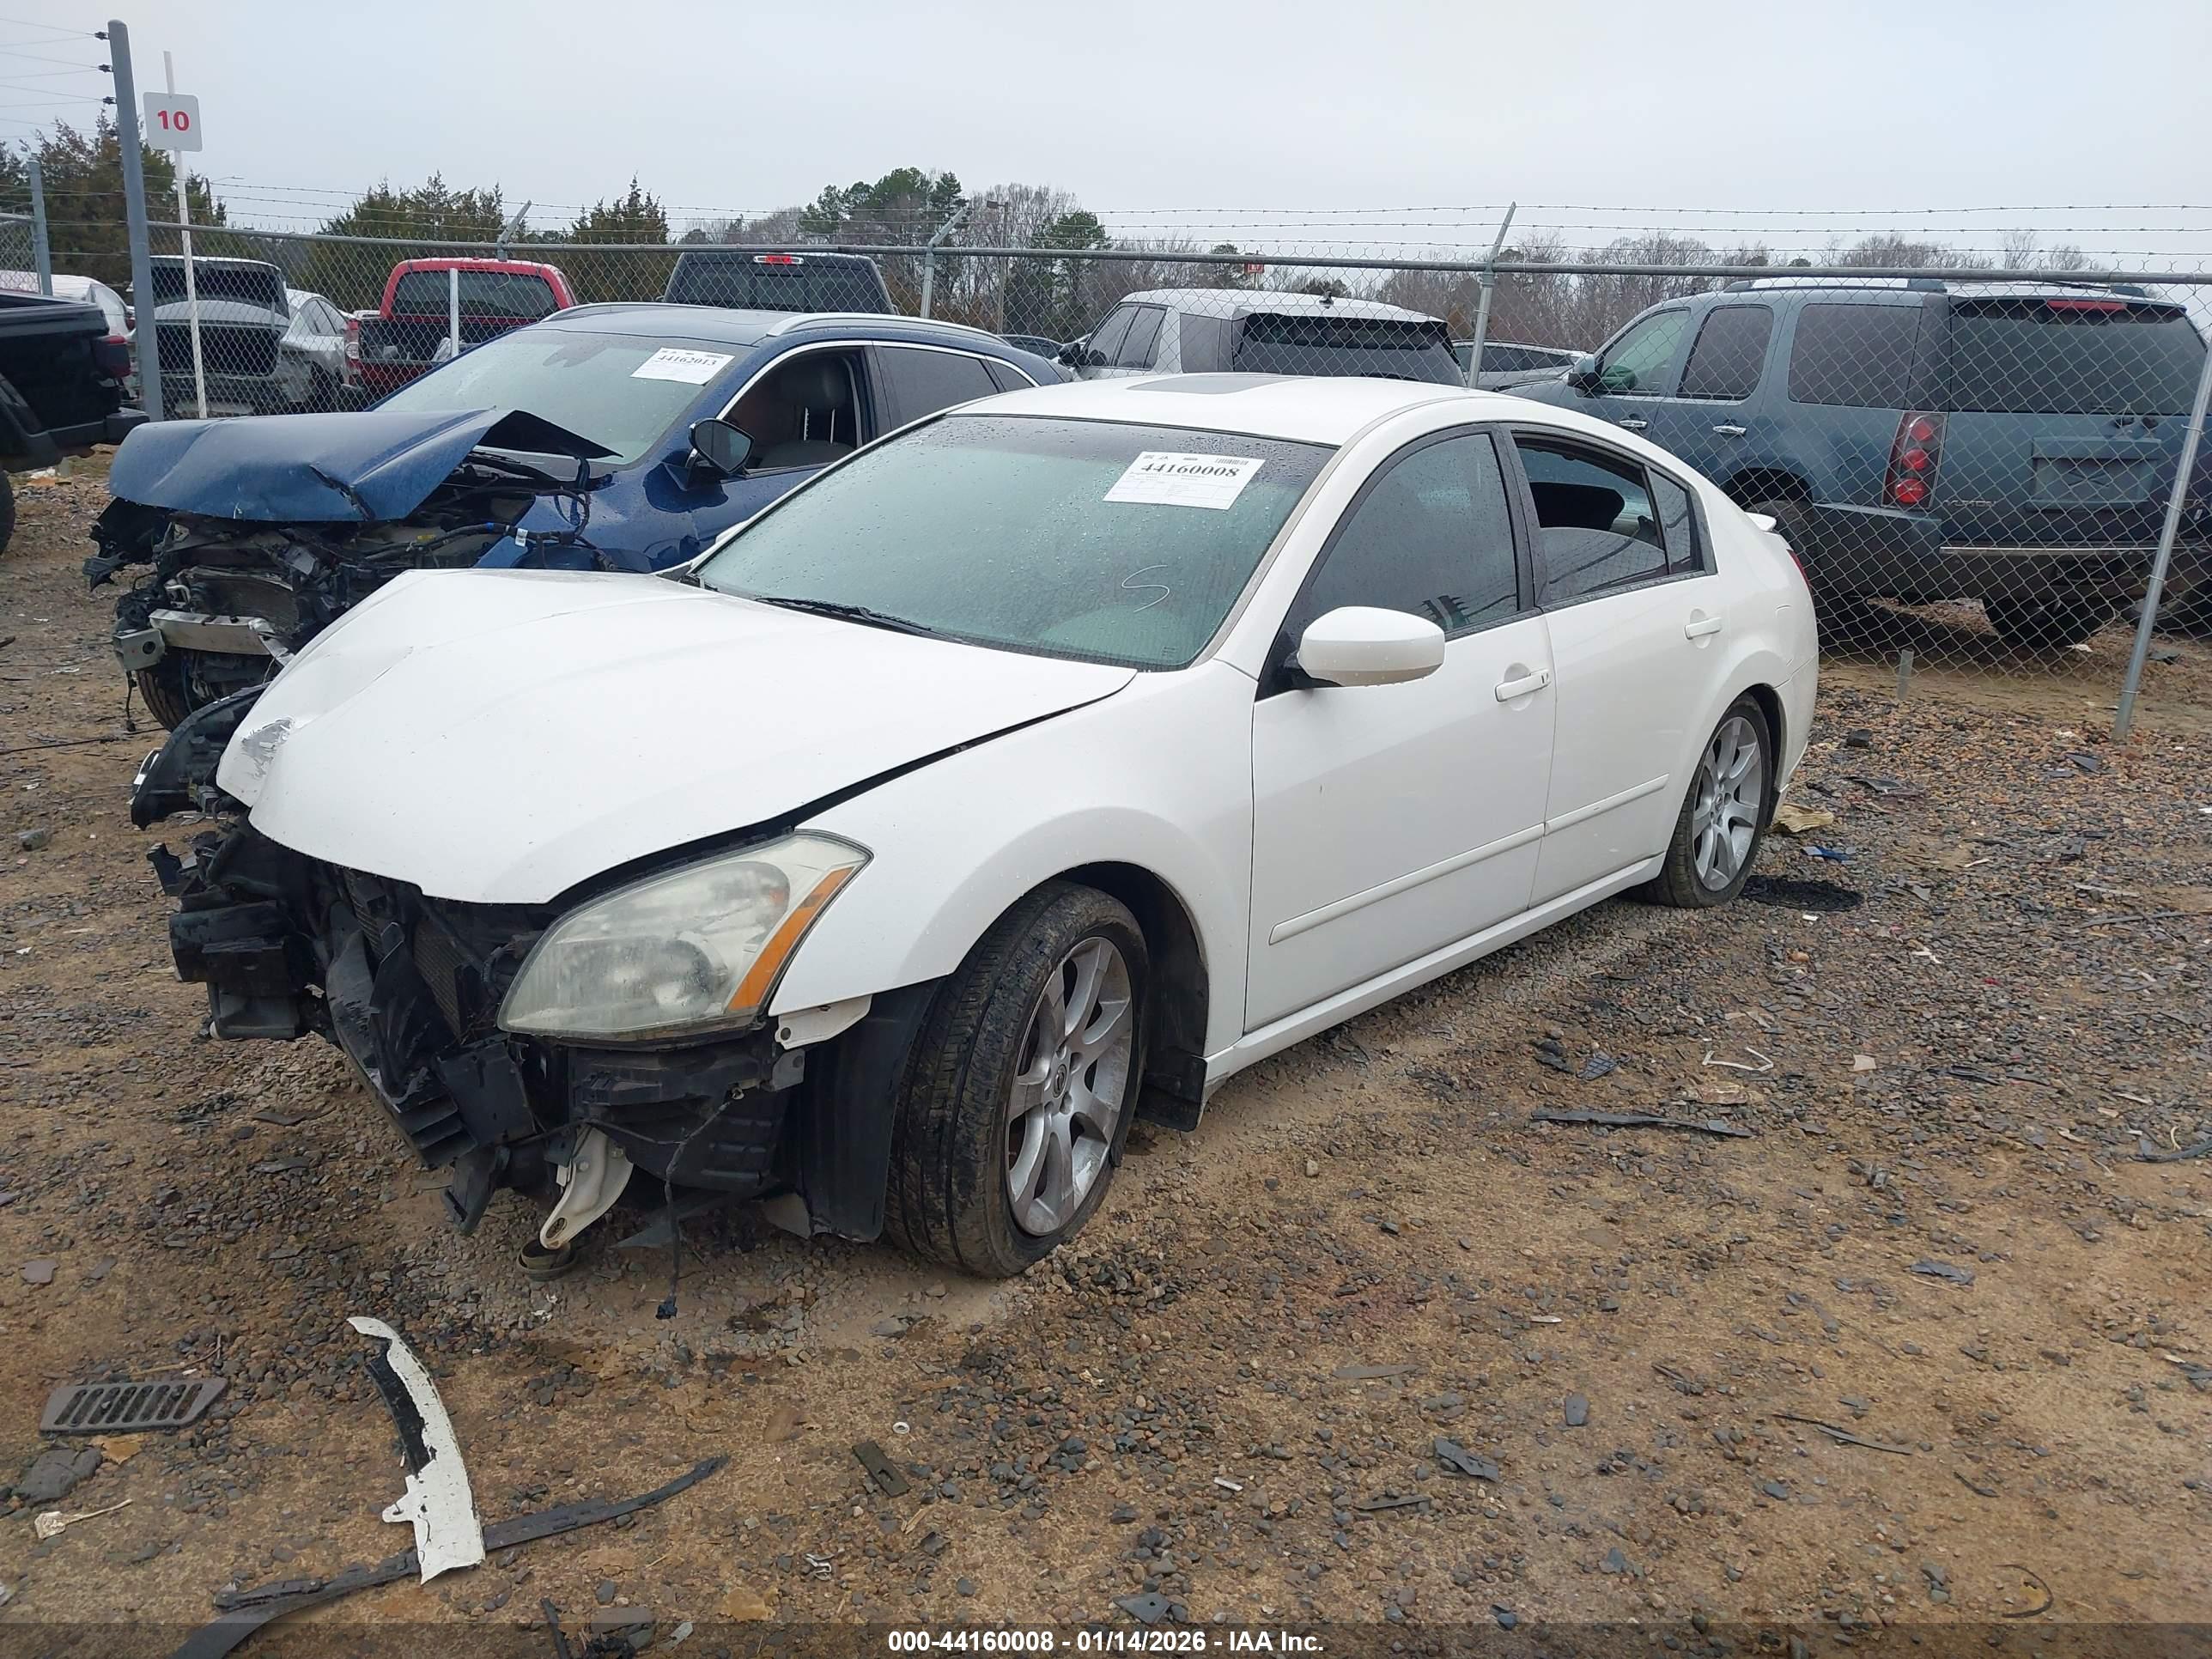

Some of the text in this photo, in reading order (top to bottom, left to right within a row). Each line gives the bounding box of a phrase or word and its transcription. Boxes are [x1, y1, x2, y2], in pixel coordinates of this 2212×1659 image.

[157, 110, 190, 131] 10
[657, 355, 717, 366] 44162013
[1140, 463, 1240, 477] 44160008
